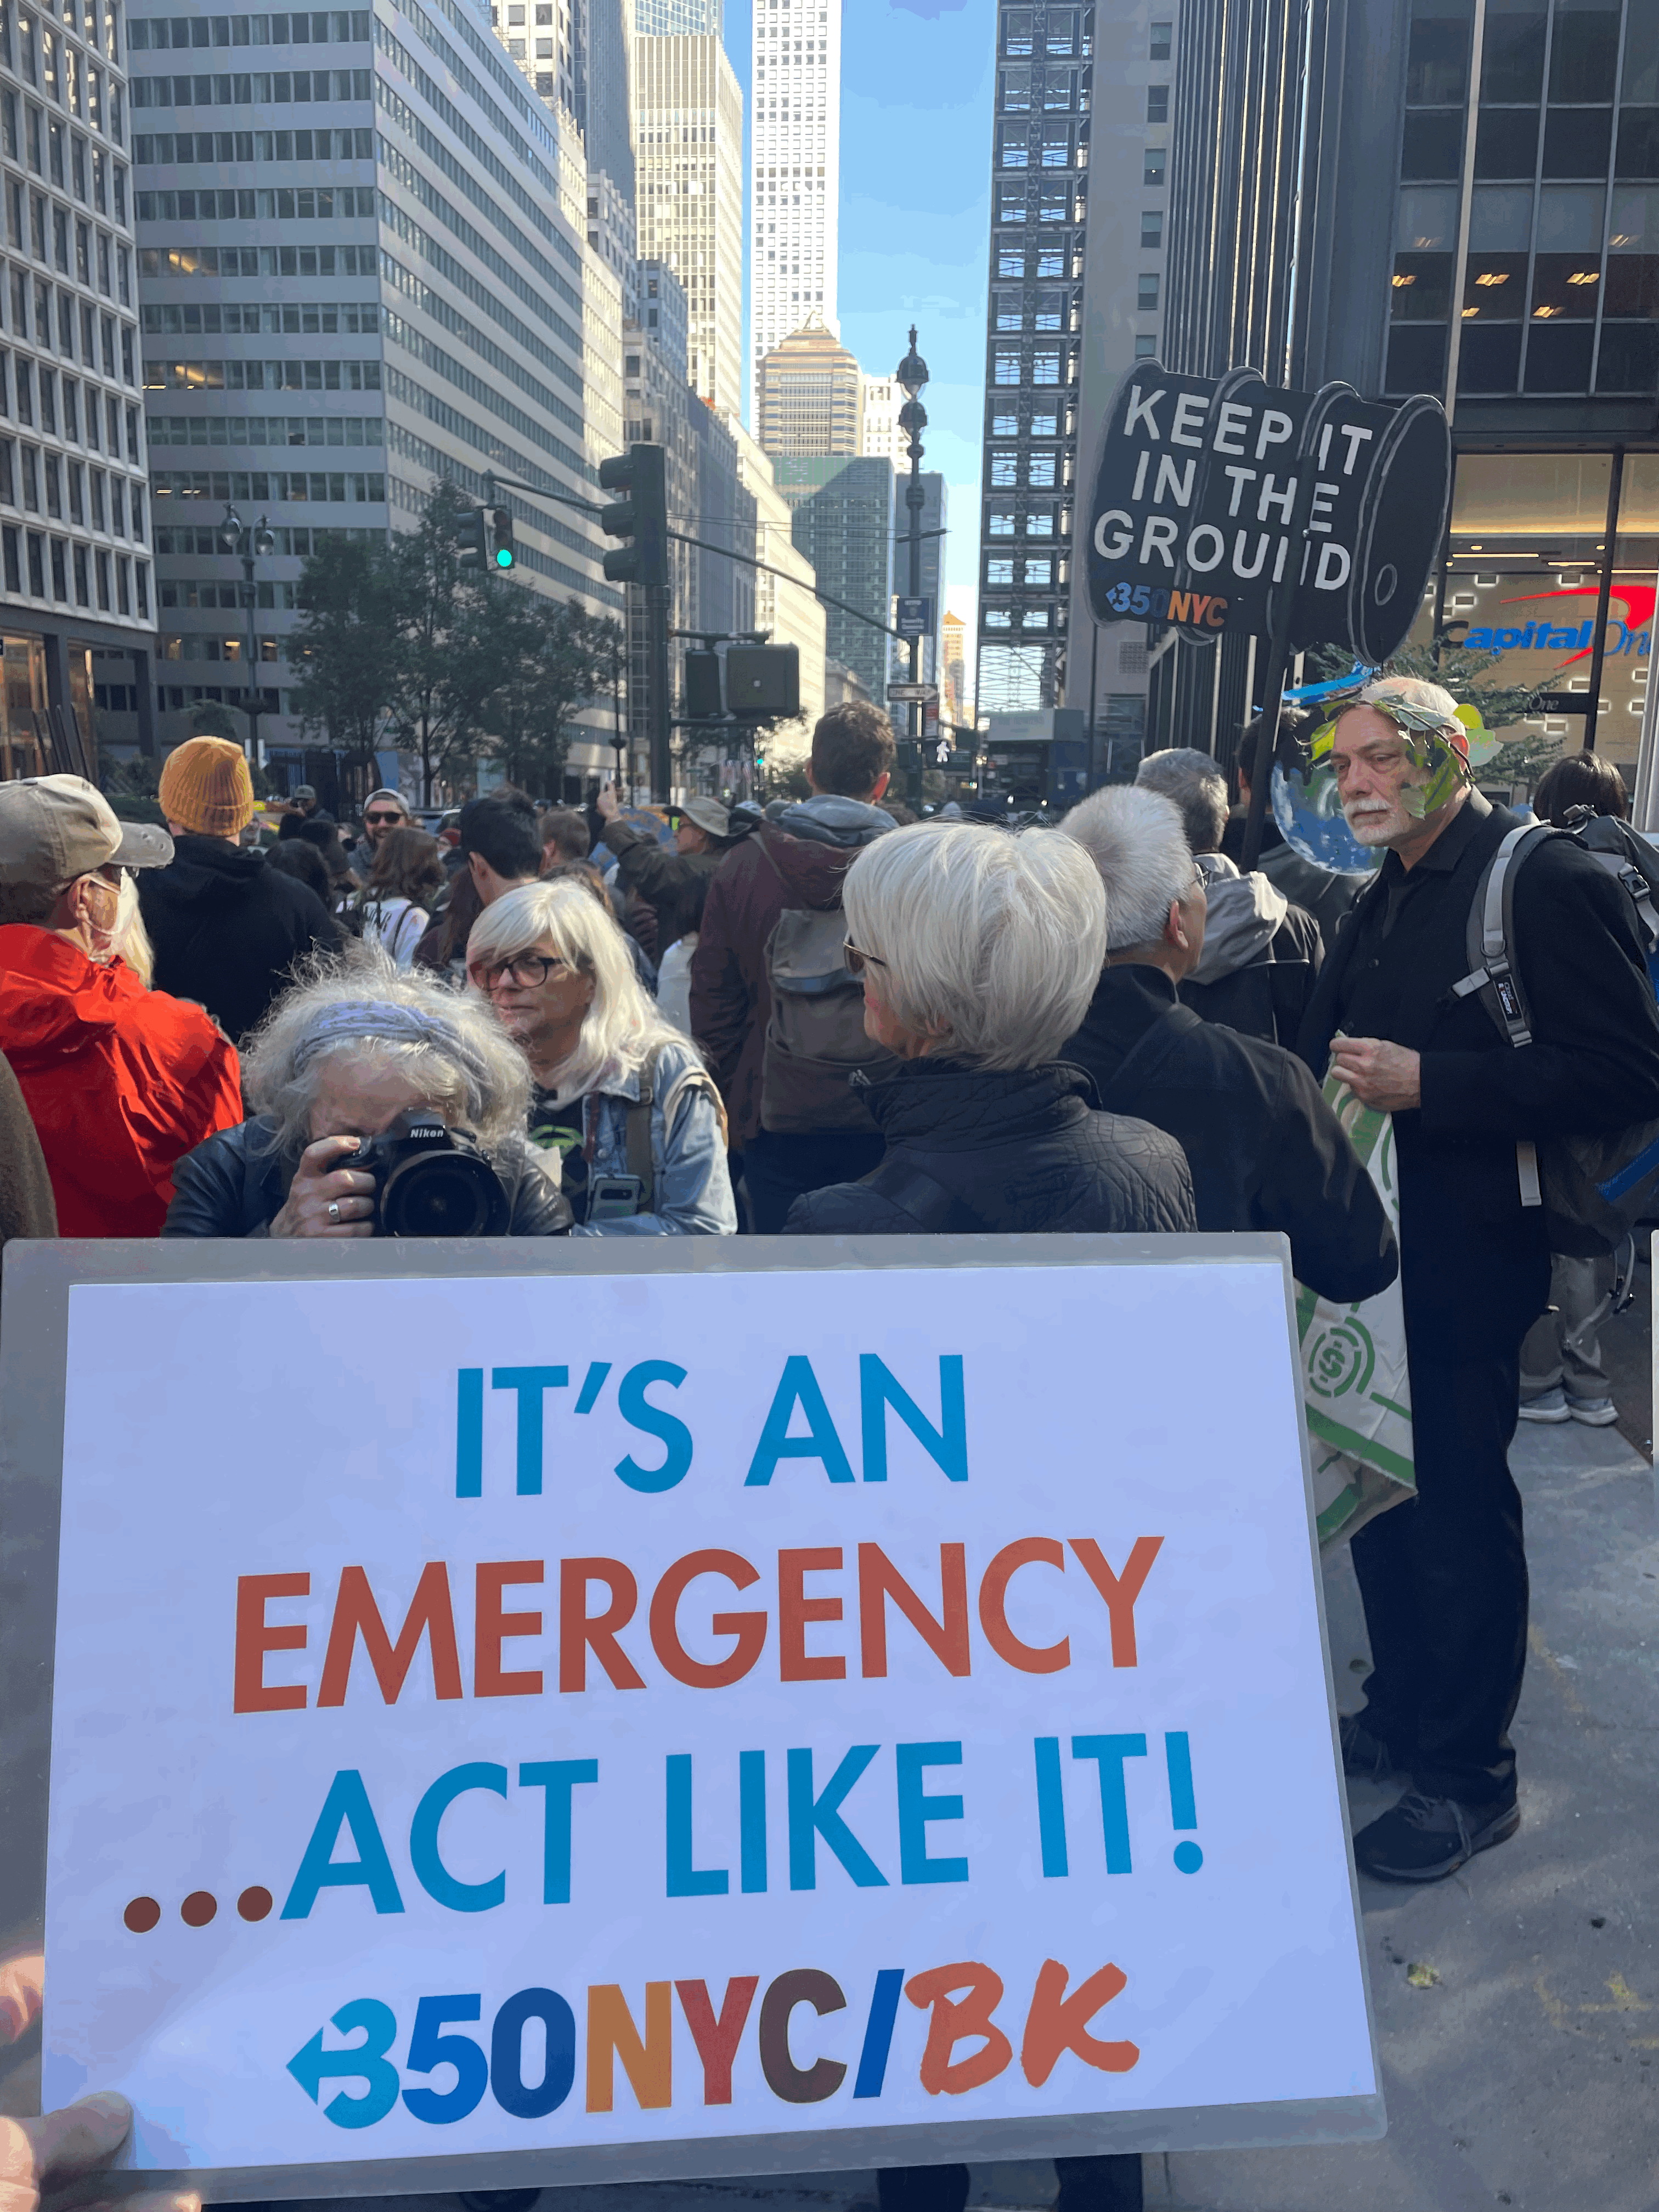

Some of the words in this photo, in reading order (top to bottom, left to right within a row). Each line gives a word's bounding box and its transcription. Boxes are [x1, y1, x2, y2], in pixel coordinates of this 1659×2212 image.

[1124, 385, 1293, 460] KEEP
[1318, 424, 1373, 475] IT
[1132, 450, 1197, 507] IN
[1224, 465, 1339, 533] THE
[1111, 582, 1228, 627] 350NYC
[1440, 619, 1593, 655] Capital
[1602, 619, 1651, 657] On
[1528, 694, 1559, 710] One
[410, 1128, 444, 1138] Nikon
[455, 1359, 693, 1499] IT'S
[743, 1353, 968, 1487] AN
[233, 1537, 1164, 1714] EMERGENCY
[665, 1740, 969, 1898] LIKE
[1034, 1731, 1204, 1878] IT!
[296, 1960, 1139, 2130] 350NYC/BK
